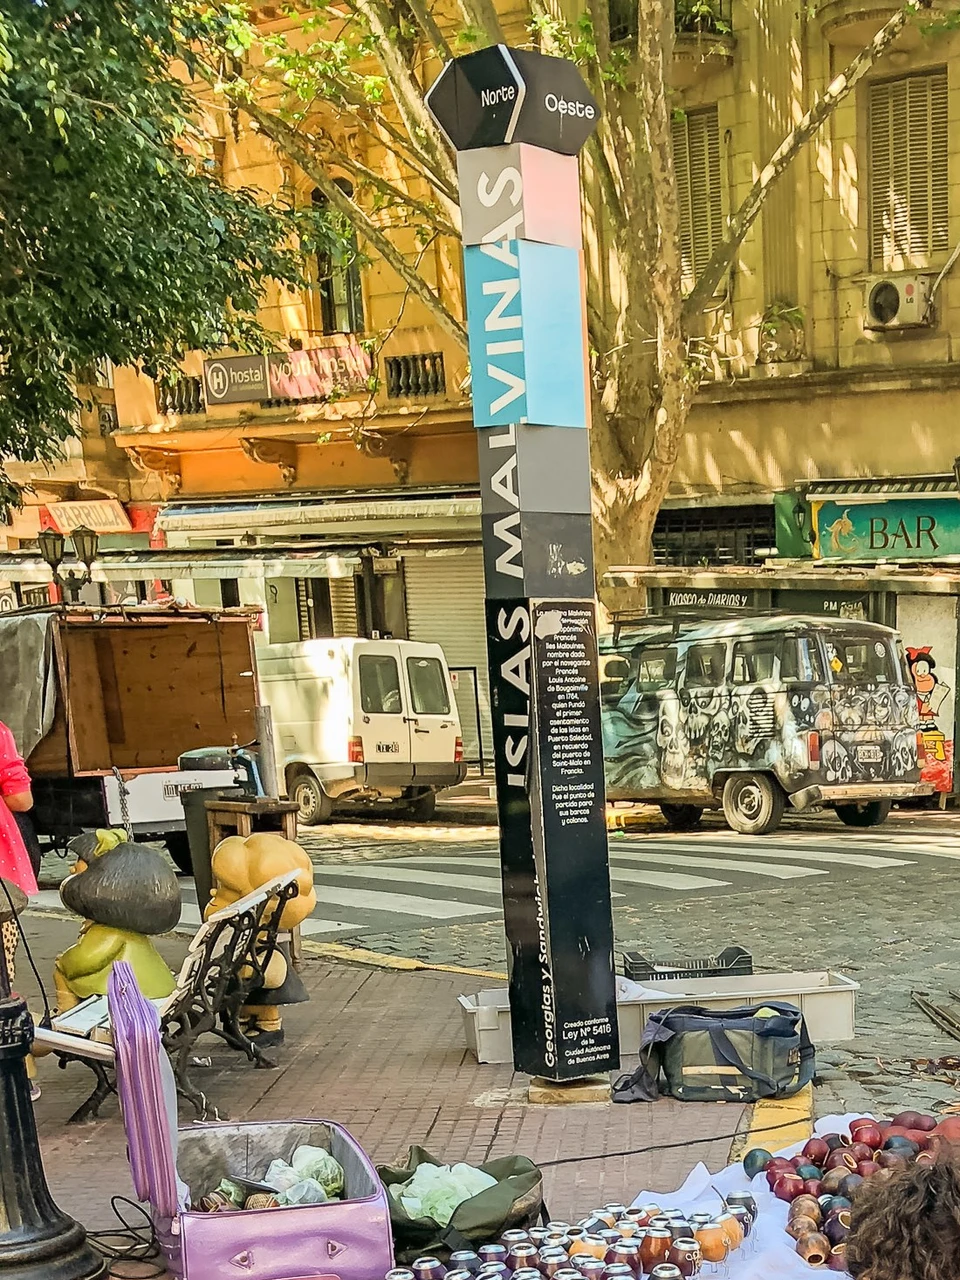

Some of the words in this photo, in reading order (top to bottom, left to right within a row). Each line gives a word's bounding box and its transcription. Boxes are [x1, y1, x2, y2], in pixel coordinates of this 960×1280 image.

[481, 84, 515, 107] Norte
[545, 93, 595, 120] Oeste
[230, 365, 263, 383] hostal
[477, 166, 528, 580] MALVINAS
[52, 503, 126, 528] PARRILLA
[869, 516, 940, 551] BAR
[669, 592, 697, 606] KIOSCO
[707, 592, 741, 606] DIARIOS
[542, 660, 553, 668] por
[497, 606, 531, 787] ISLAS
[563, 710, 582, 718] primer
[562, 742, 588, 750] recuerdo
[552, 784, 568, 792] Dicha
[555, 801, 577, 809] partida
[541, 990, 555, 1068] Georgias
[562, 1030, 579, 1041] Ley
[592, 1023, 612, 1035] 5416
